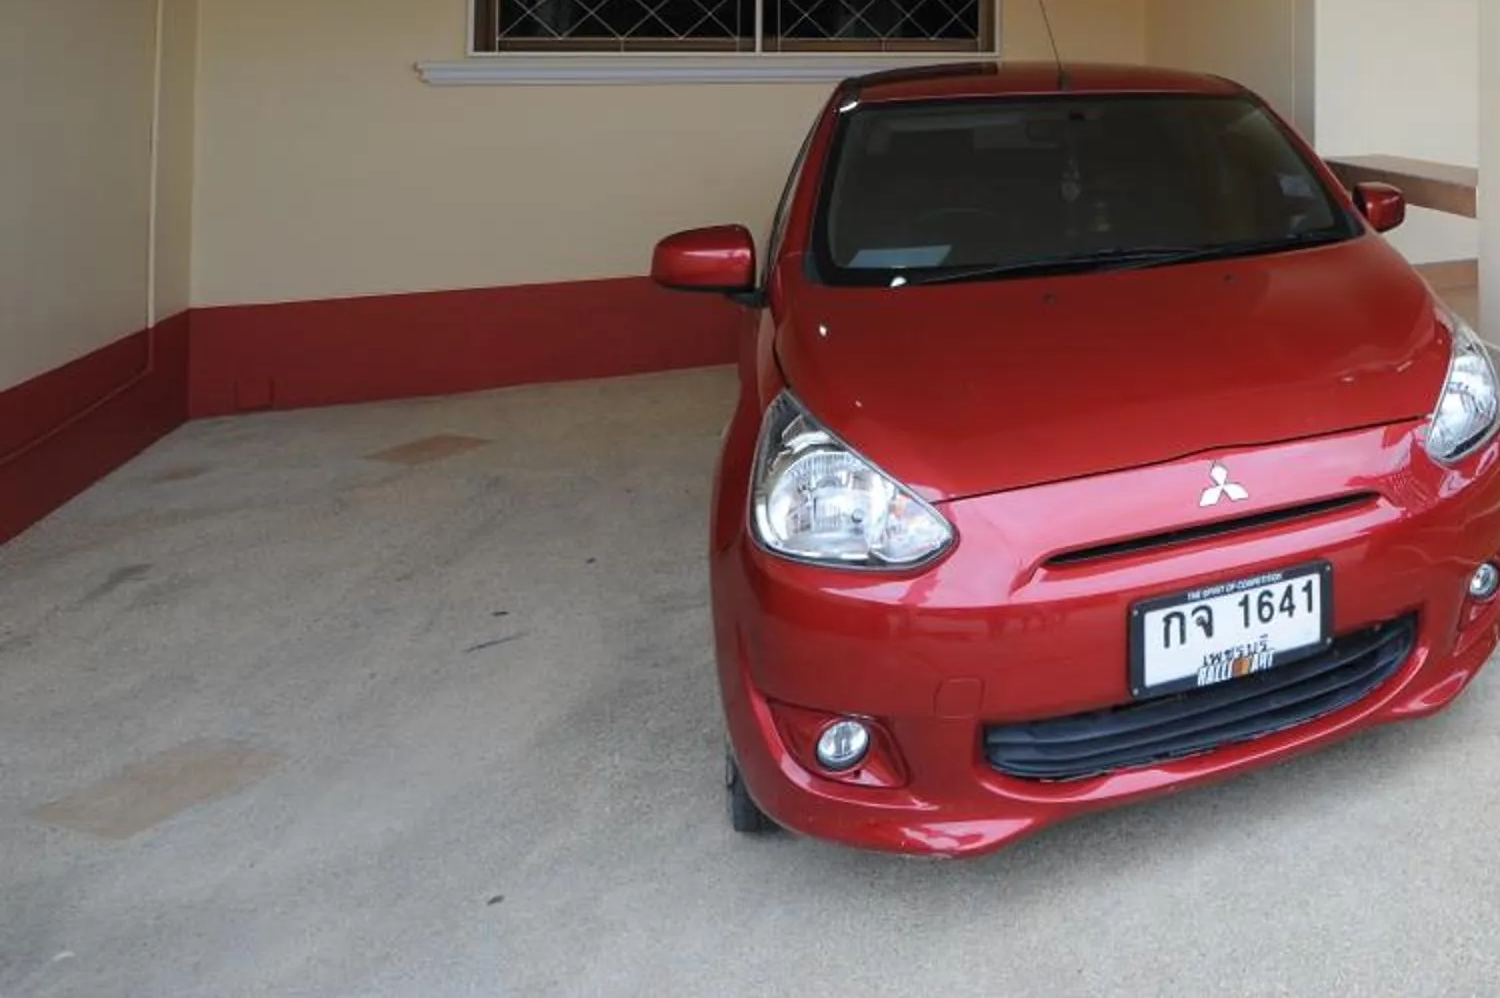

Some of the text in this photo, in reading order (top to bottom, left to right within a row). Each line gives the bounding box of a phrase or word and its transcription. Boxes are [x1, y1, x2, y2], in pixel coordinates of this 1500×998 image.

[1238, 579, 1314, 628] 1641
[1162, 604, 1213, 648] กจ
[1203, 633, 1268, 667] เพชรบรี
